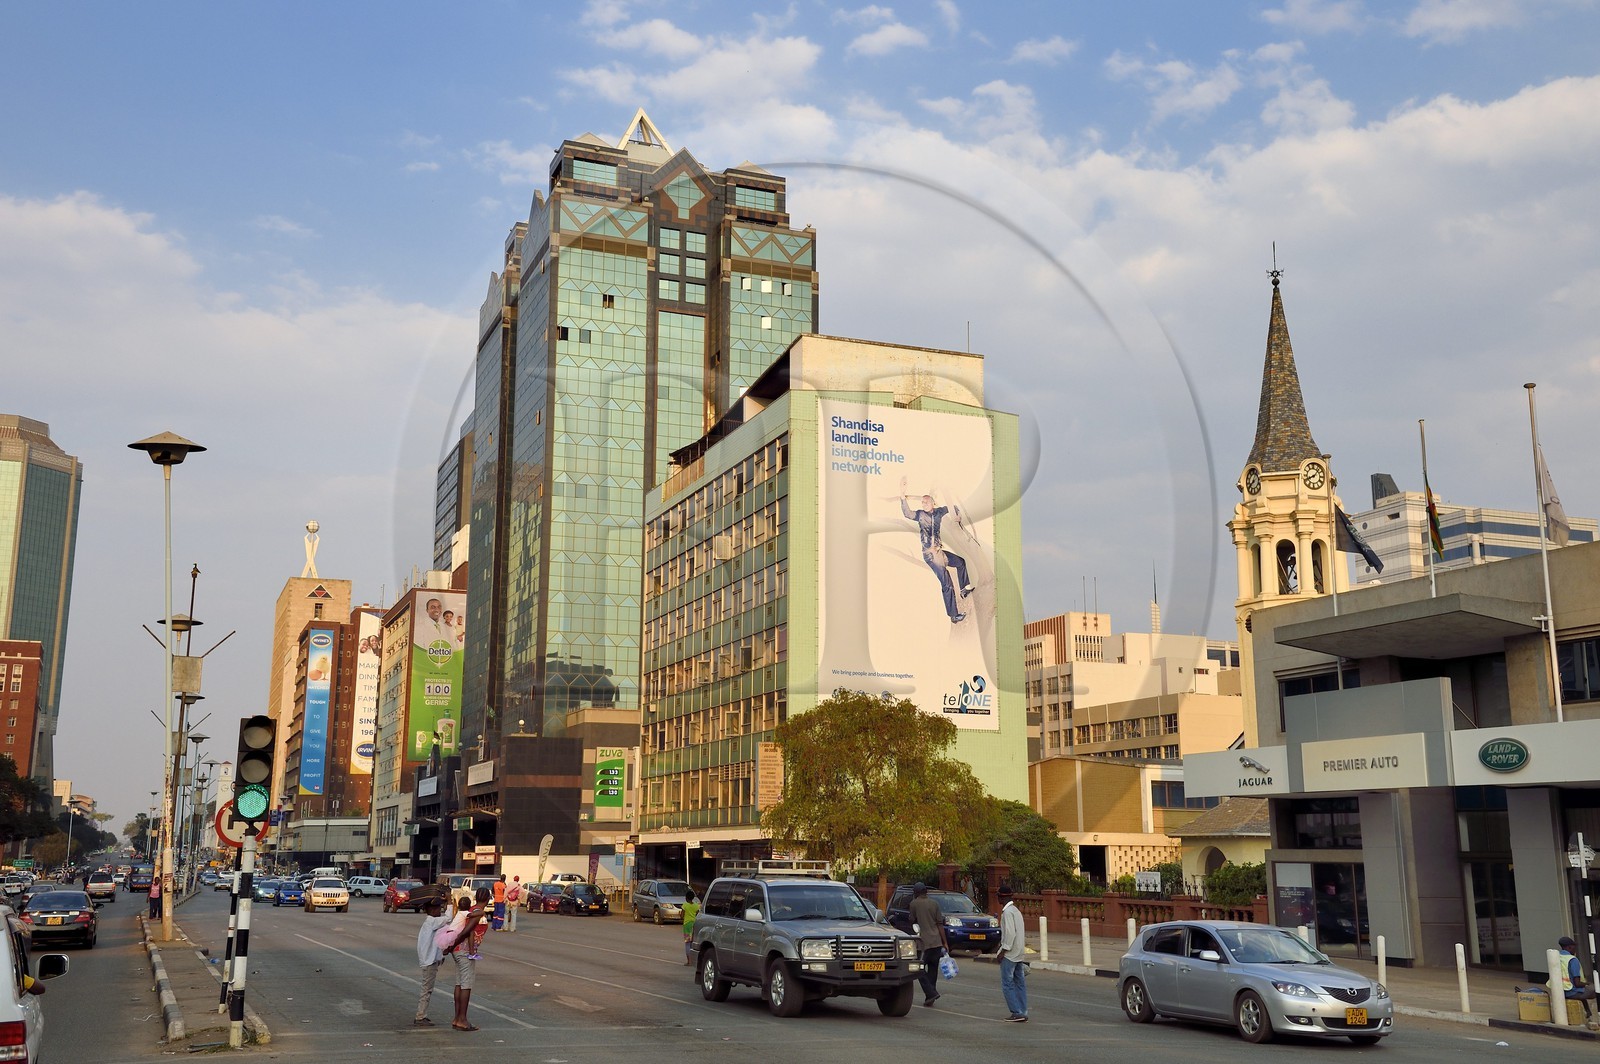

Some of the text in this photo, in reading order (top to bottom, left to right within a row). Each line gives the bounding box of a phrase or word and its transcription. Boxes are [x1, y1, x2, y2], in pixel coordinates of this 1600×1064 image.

[831, 415, 885, 433] Shandisa
[831, 429, 879, 446] landline
[831, 444, 905, 463] isingadonhe
[831, 461, 882, 475] network
[428, 647, 452, 656] Dettol
[426, 685, 450, 694] 100
[1488, 743, 1512, 754] LAND
[1322, 755, 1399, 772] PREMIER AUTO
[1491, 754, 1520, 764] ROVER
[1238, 776, 1273, 788] JAGUAR
